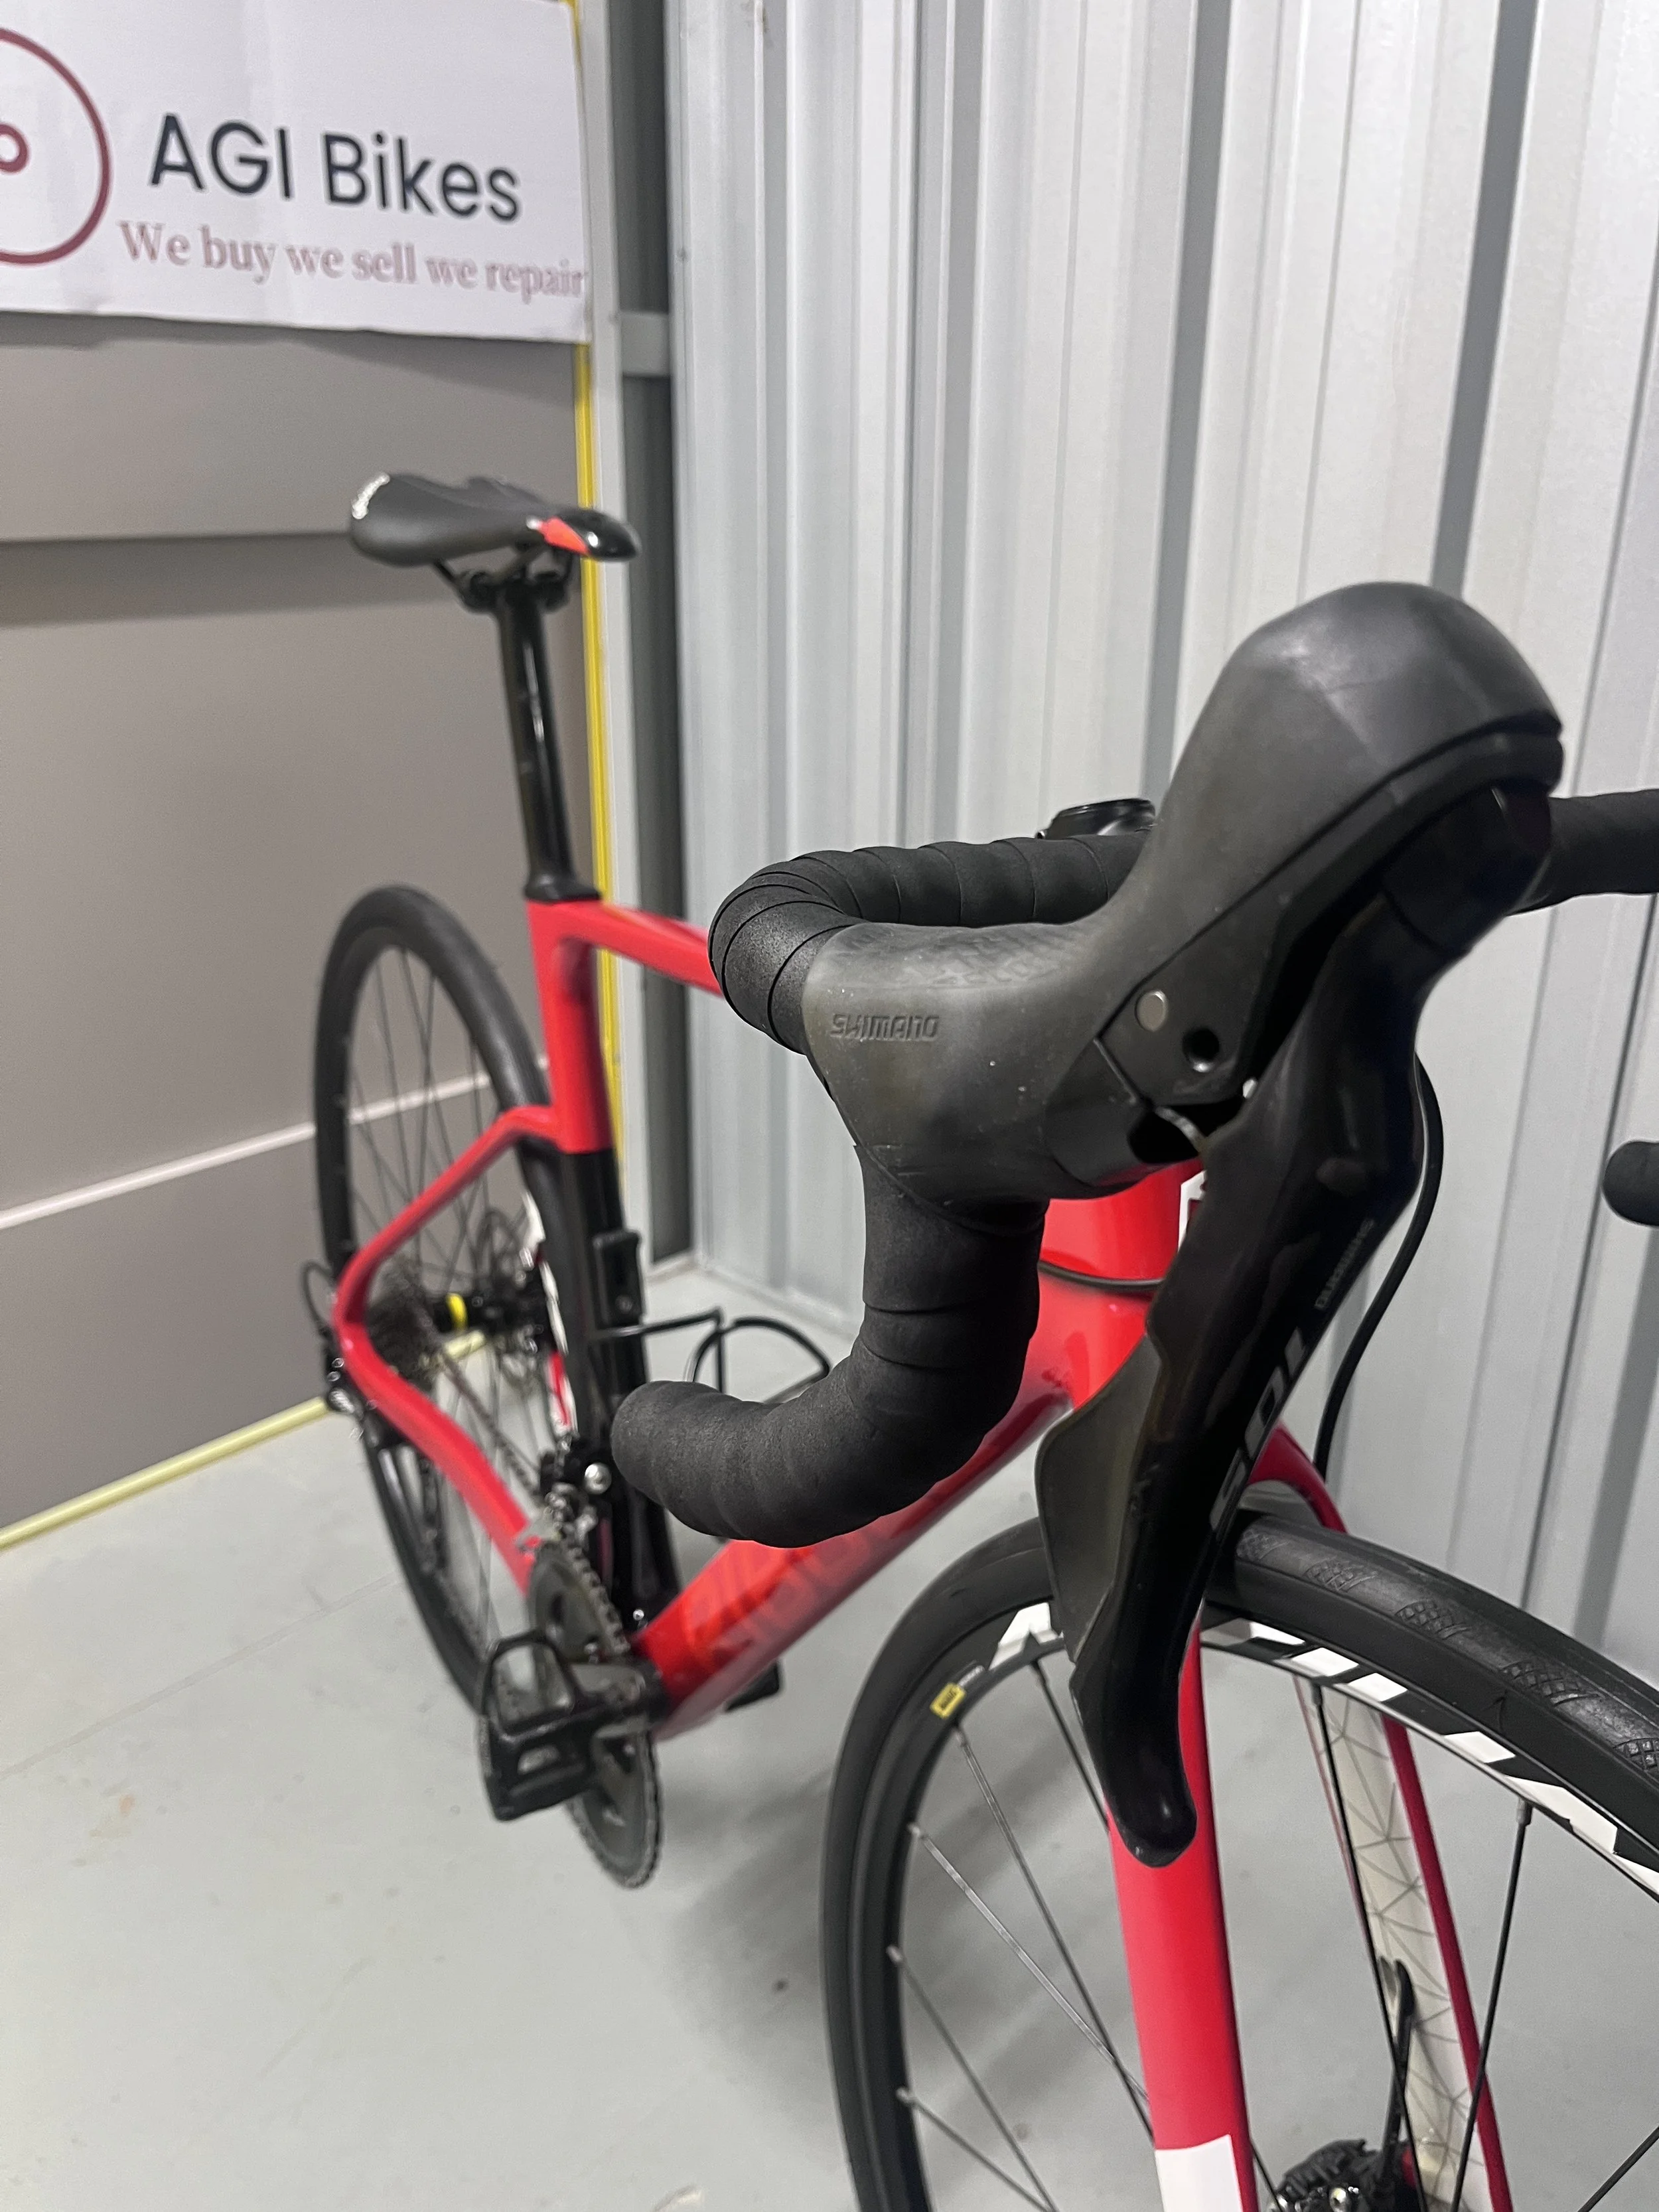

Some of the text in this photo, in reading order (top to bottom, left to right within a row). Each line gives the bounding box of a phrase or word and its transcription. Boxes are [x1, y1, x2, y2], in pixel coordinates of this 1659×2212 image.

[149, 112, 522, 223] AGI Bikes
[117, 220, 585, 304] We buy we sell we repair
[830, 1013, 940, 1041] SHIMANO
